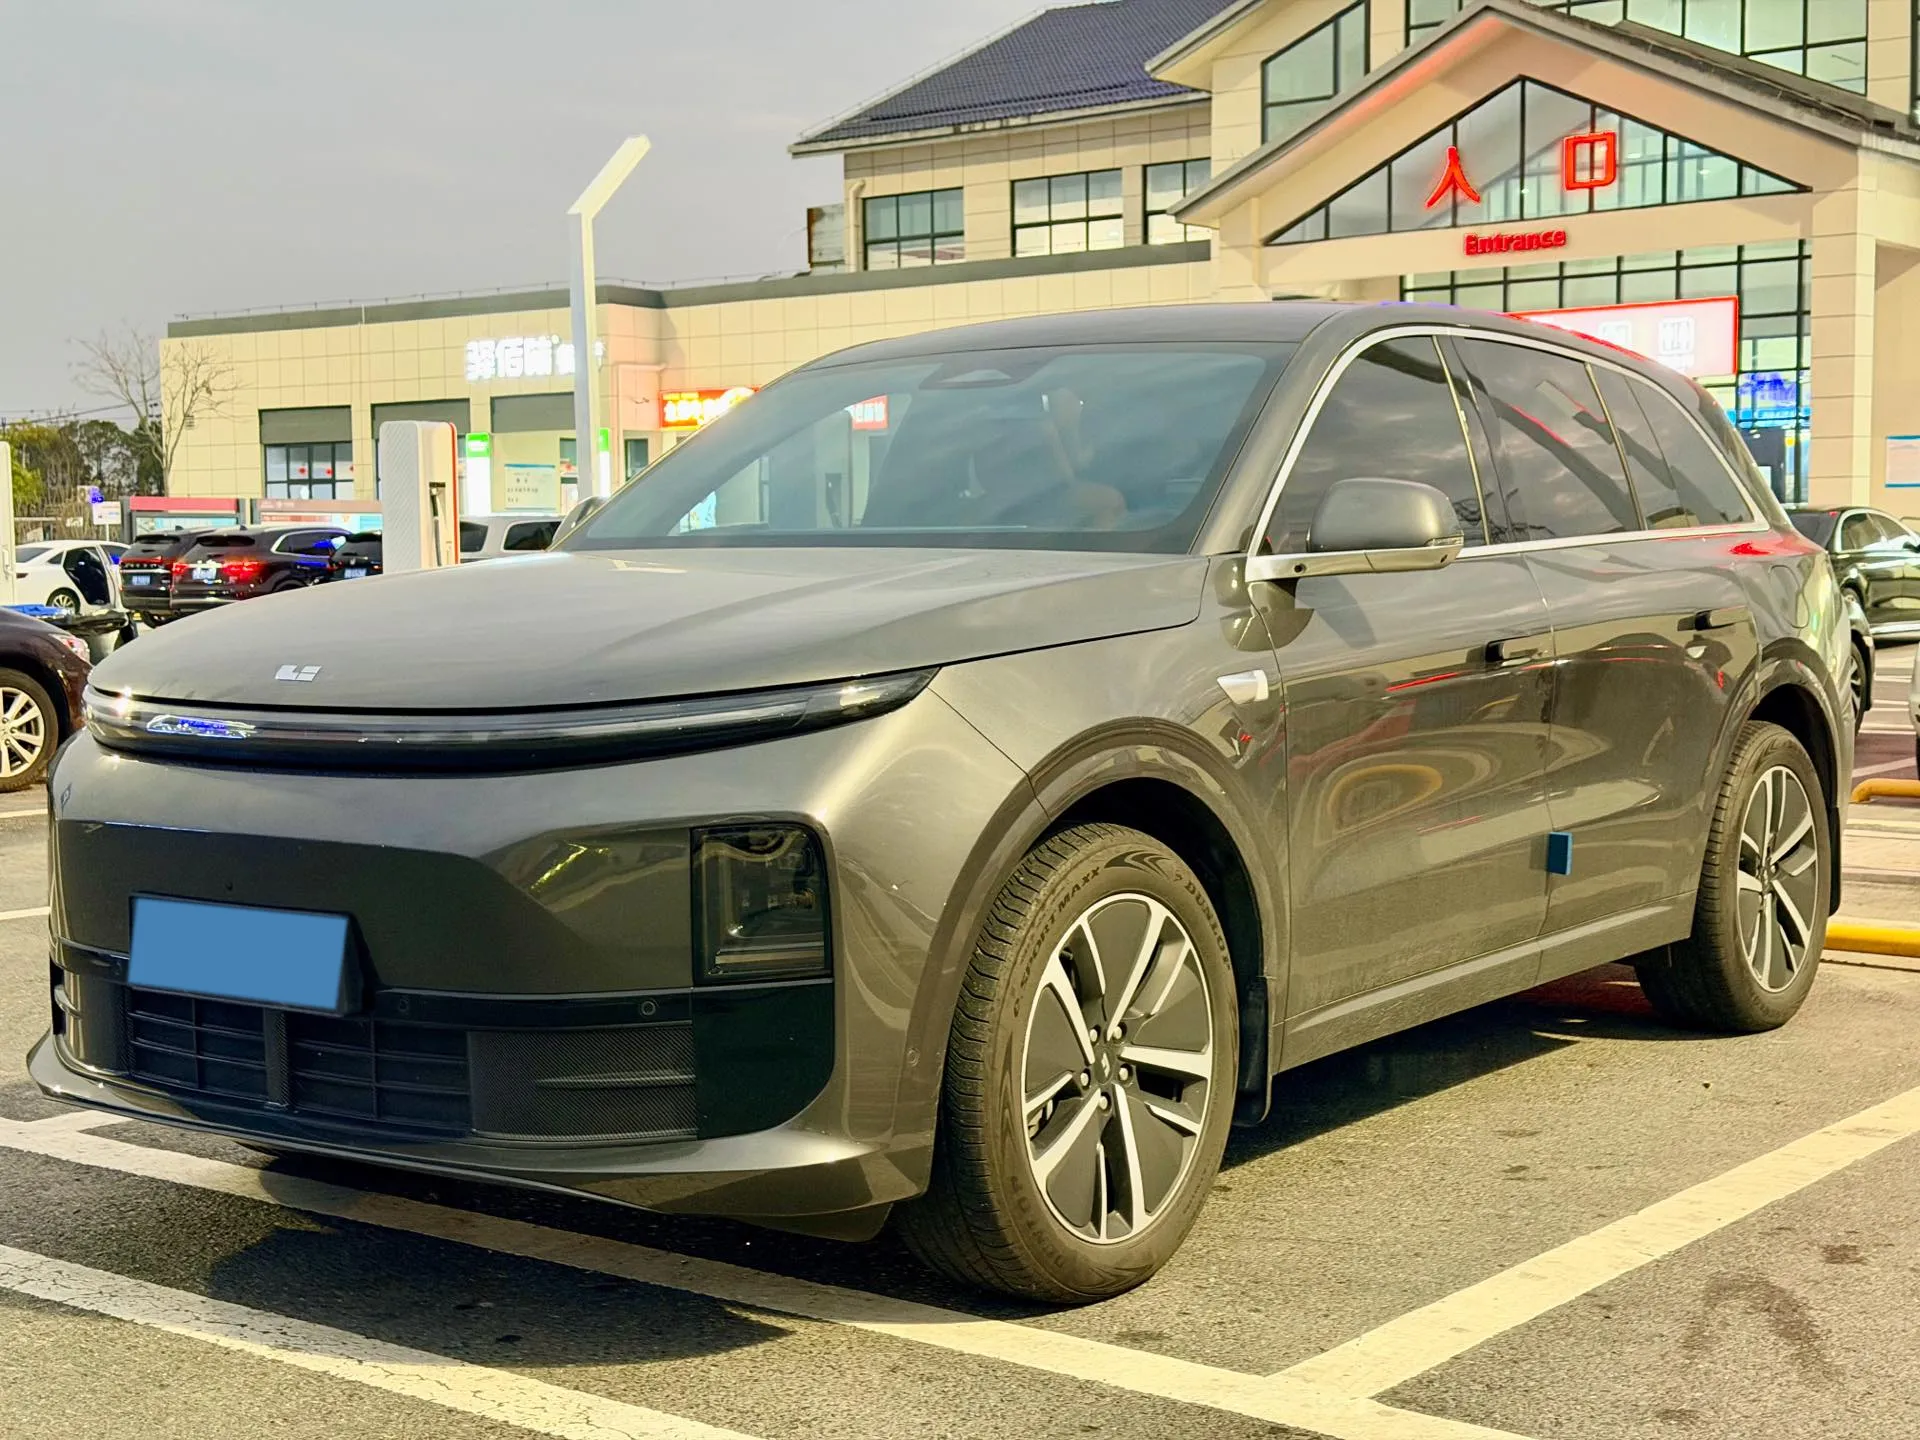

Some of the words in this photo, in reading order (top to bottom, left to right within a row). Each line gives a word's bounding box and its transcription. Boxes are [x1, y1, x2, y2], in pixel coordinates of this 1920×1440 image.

[1464, 230, 1567, 256] Entrance
[1058, 865, 1101, 912] MAXX
[1184, 880, 1232, 970] DUNLOP
